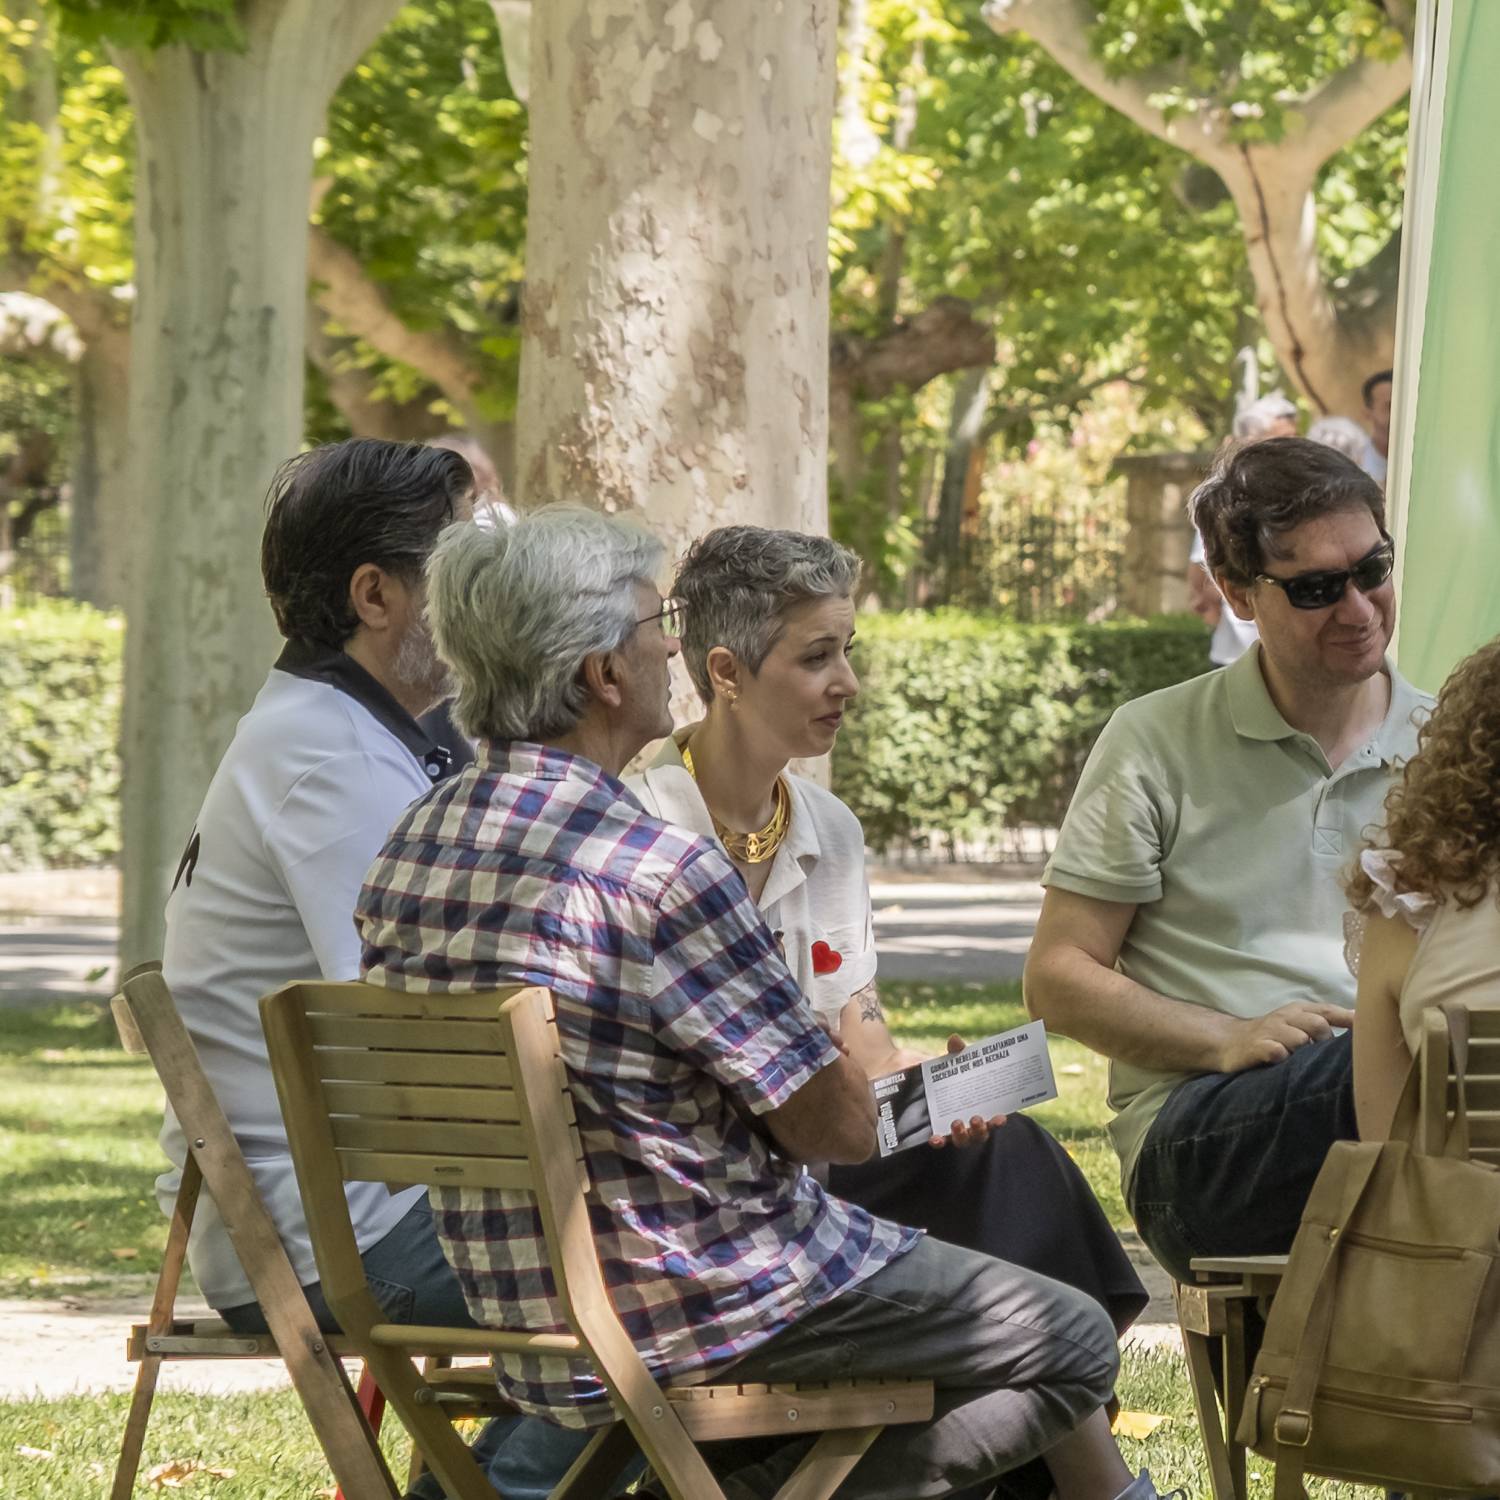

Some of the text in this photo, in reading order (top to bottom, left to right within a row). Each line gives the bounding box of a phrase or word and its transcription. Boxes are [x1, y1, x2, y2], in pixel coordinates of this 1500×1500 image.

[1016, 1033, 1029, 1043] UNA
[931, 1067, 959, 1083] SOCIEDAD
[960, 1063, 971, 1074] QUE
[984, 1049, 1010, 1065] RECHAZA
